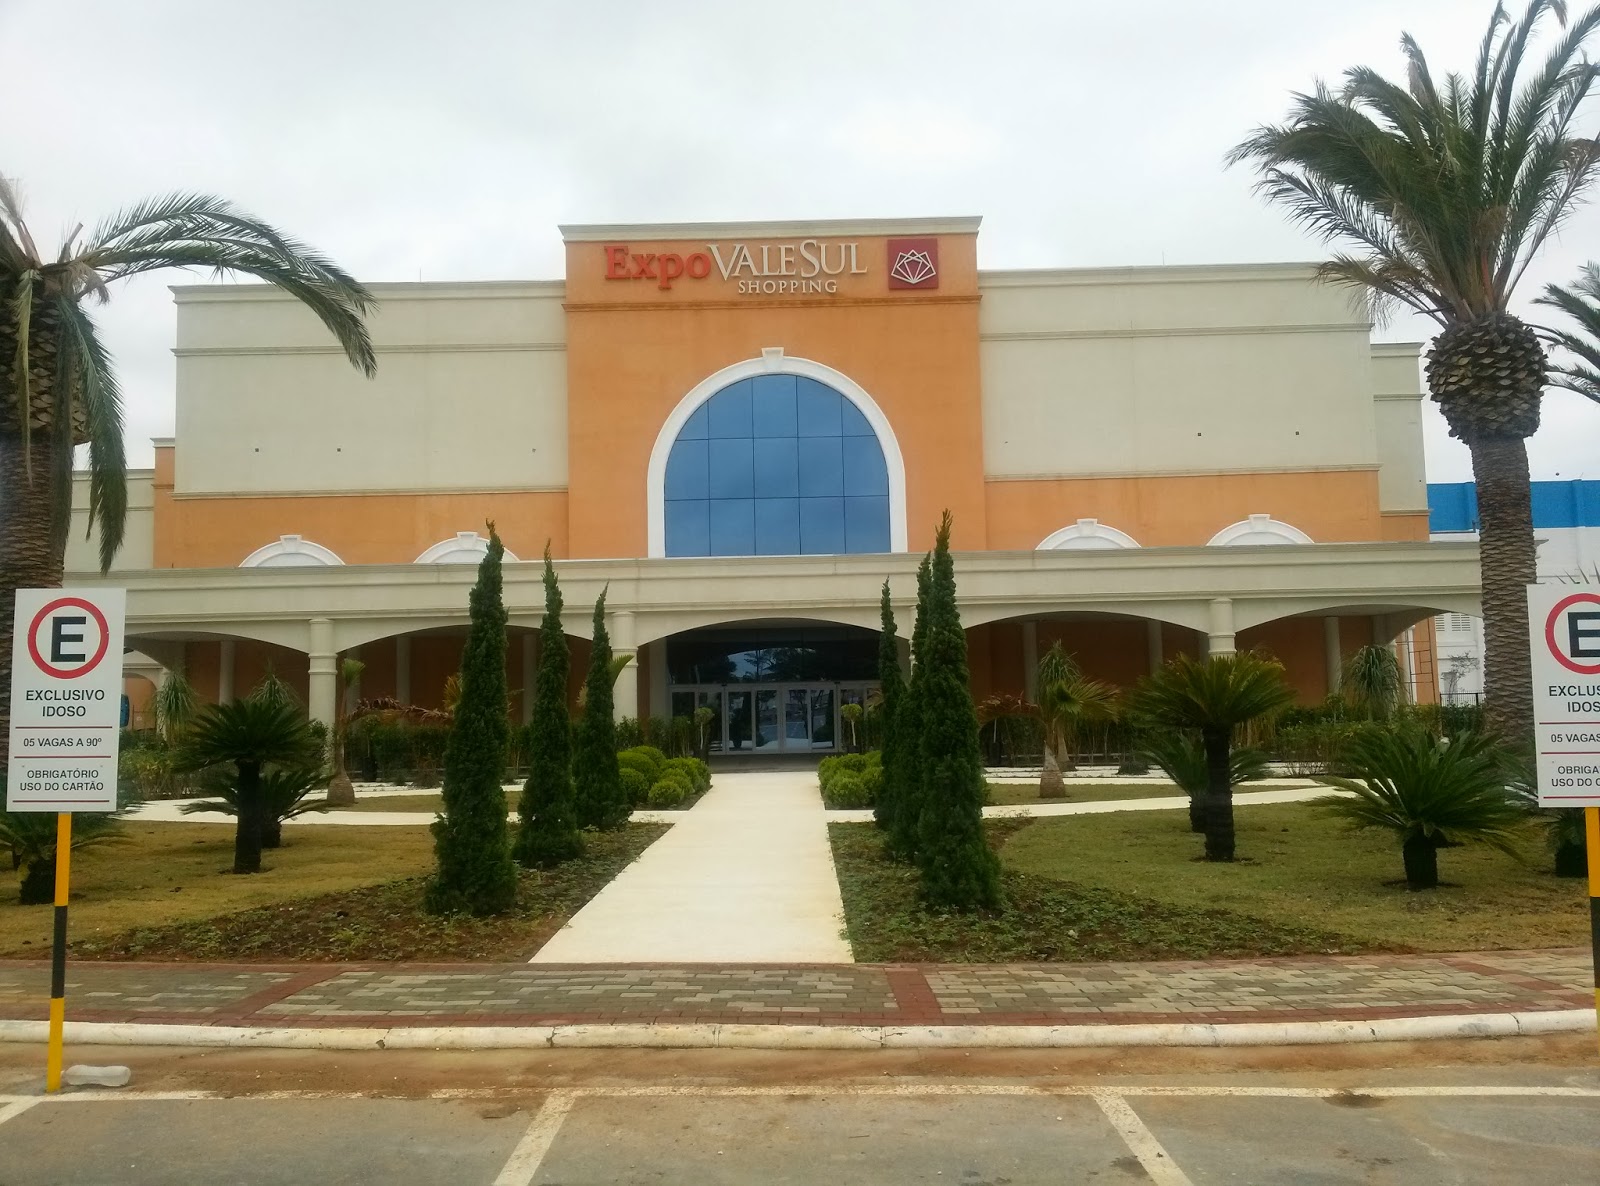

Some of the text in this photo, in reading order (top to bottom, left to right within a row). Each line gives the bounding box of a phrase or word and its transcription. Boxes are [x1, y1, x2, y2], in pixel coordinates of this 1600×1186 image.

[604, 245, 711, 290] Expo
[738, 280, 838, 294] SHOPPING
[51, 616, 87, 662] E
[25, 689, 105, 701] EXCLUSIVO
[42, 706, 86, 717] IDOSO
[23, 738, 35, 747] 05
[37, 738, 73, 747] VAGAS
[76, 738, 84, 747] A
[1550, 733, 1563, 743] 05
[27, 767, 99, 779] OBRIGATÓRIO
[1557, 765, 1600, 775] OBRIGA
[20, 780, 104, 791] USO DO CARTÃO
[1551, 778, 1574, 787] USO
[1577, 778, 1592, 787] DO
